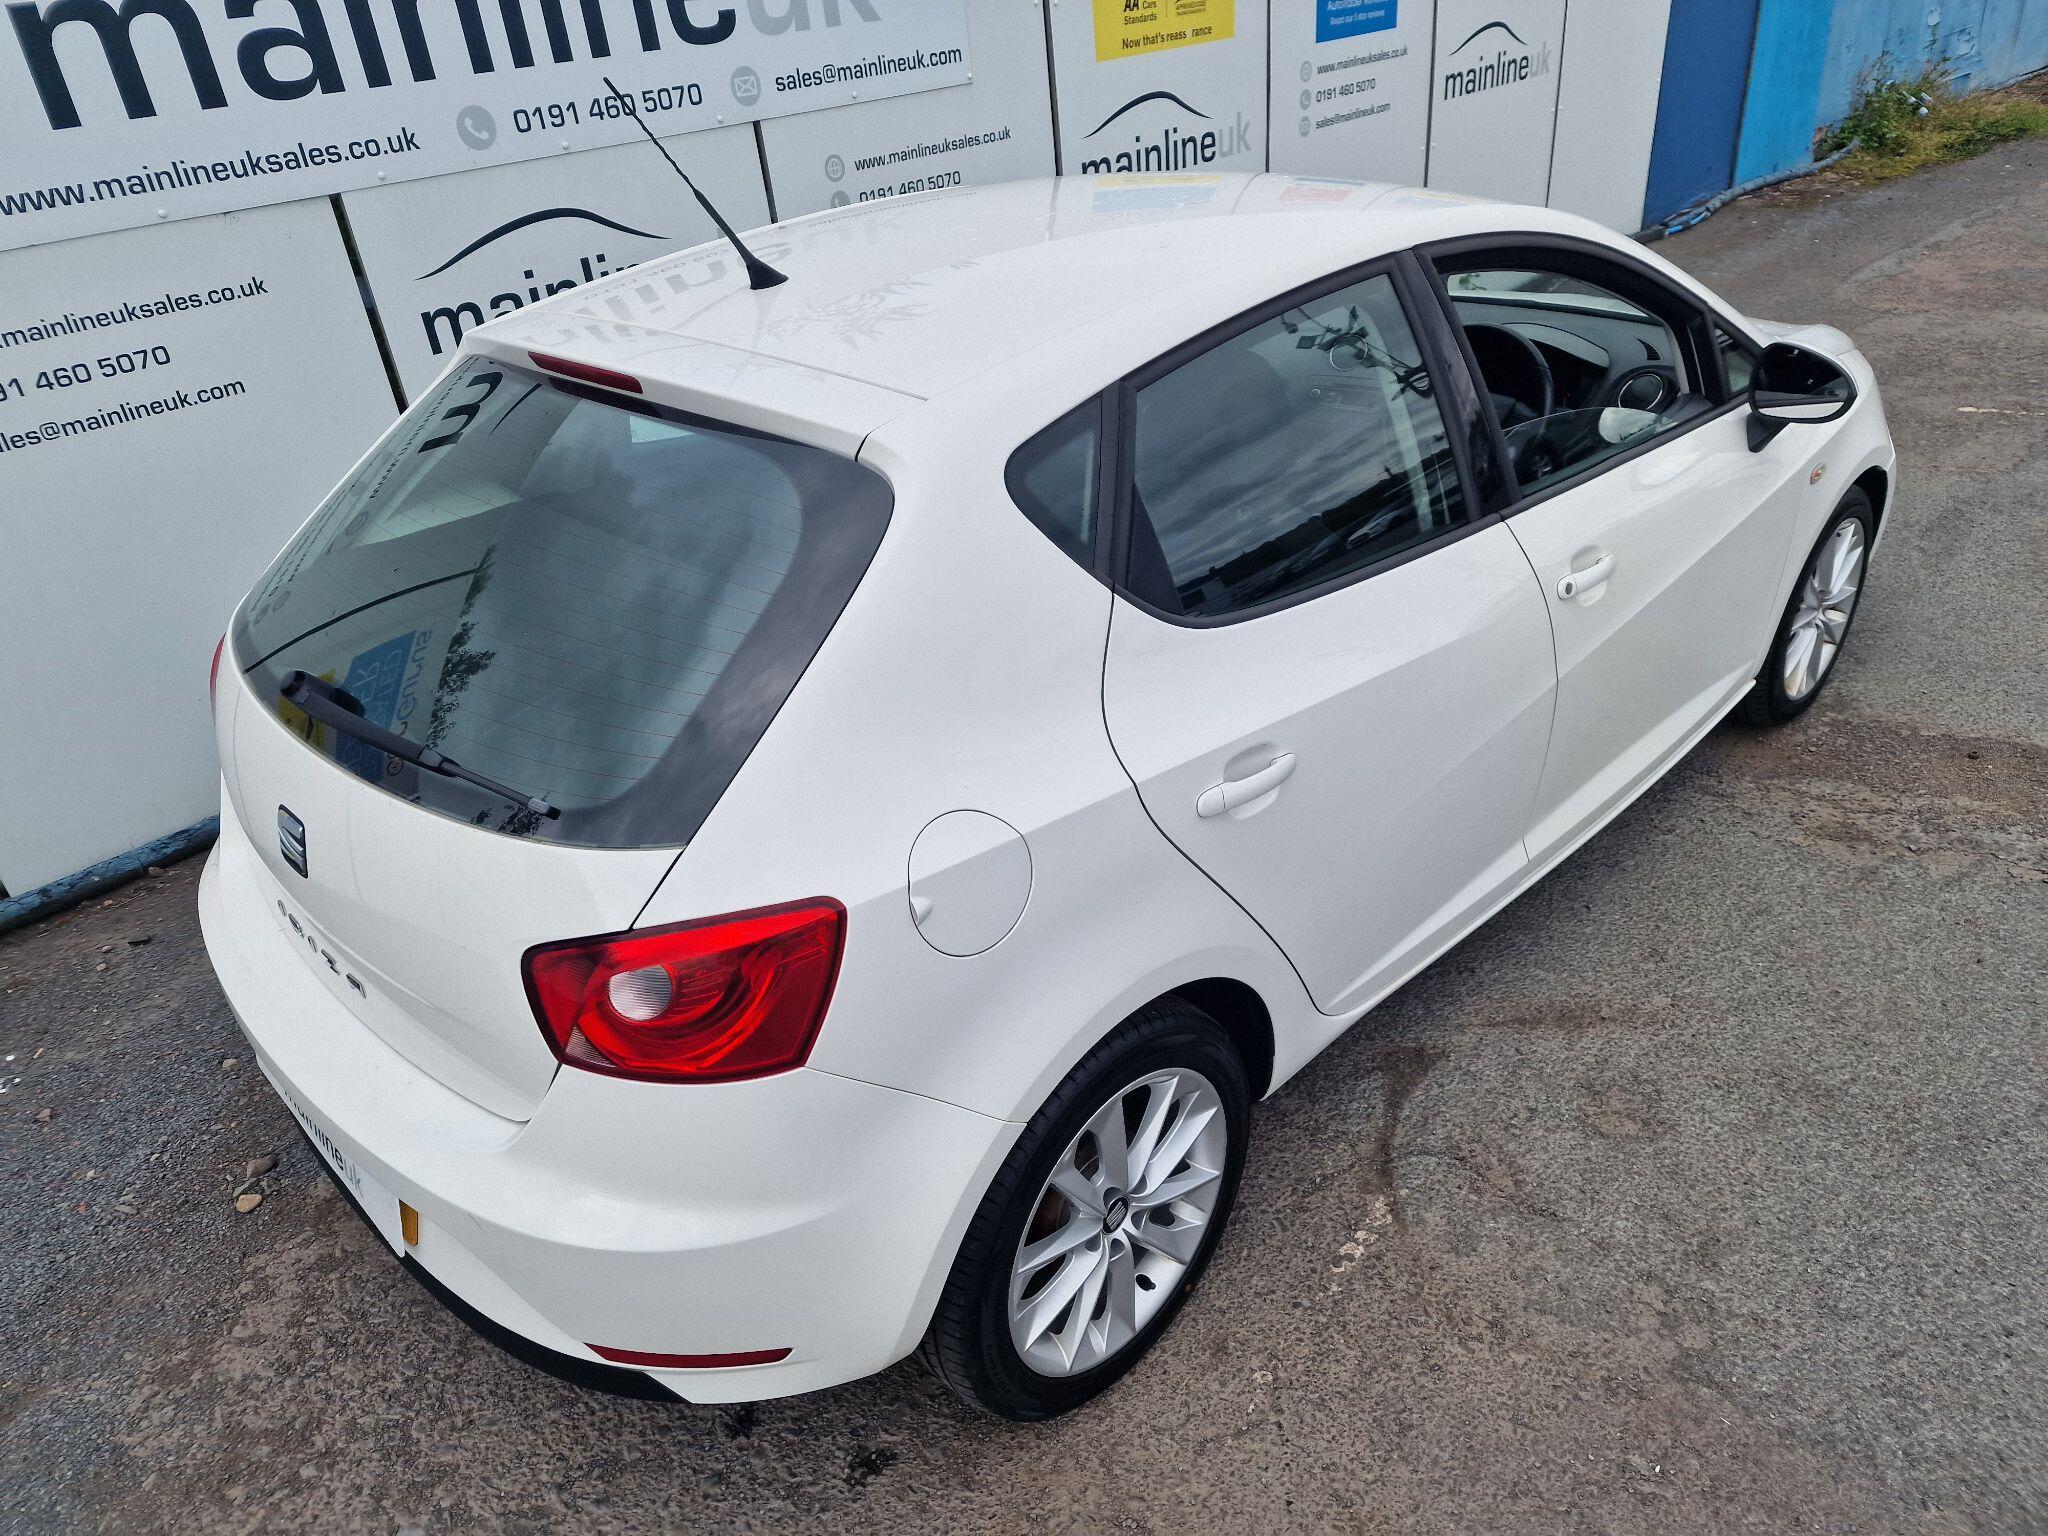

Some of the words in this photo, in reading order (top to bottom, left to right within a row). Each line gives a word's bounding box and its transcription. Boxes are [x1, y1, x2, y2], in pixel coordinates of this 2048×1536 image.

[1122, 36, 1141, 50] Now
[1142, 31, 1165, 46] that's
[1123, 12, 1158, 26] Standards
[775, 46, 963, 93] sales@mainlineuk.com
[1317, 44, 1409, 74] www.mainlineuksales.co.uk
[1443, 41, 1551, 101] mainlineuk
[513, 101, 580, 134] 0191
[589, 93, 636, 120] 460
[641, 83, 703, 112] 5070
[1316, 87, 1338, 103] 0191
[1356, 78, 1377, 93] 5070
[854, 125, 1012, 171] www.mainlineuksales.co.uk
[1081, 112, 1252, 175] mainlineuk
[0, 126, 422, 216] www.mainlineuksales.co.uk
[859, 185, 894, 203] 0191
[898, 179, 925, 195] 460
[928, 171, 962, 190] 5070
[36, 362, 92, 391] 460
[97, 345, 171, 379] 5070
[0, 379, 246, 452] les@mainlineuk.com
